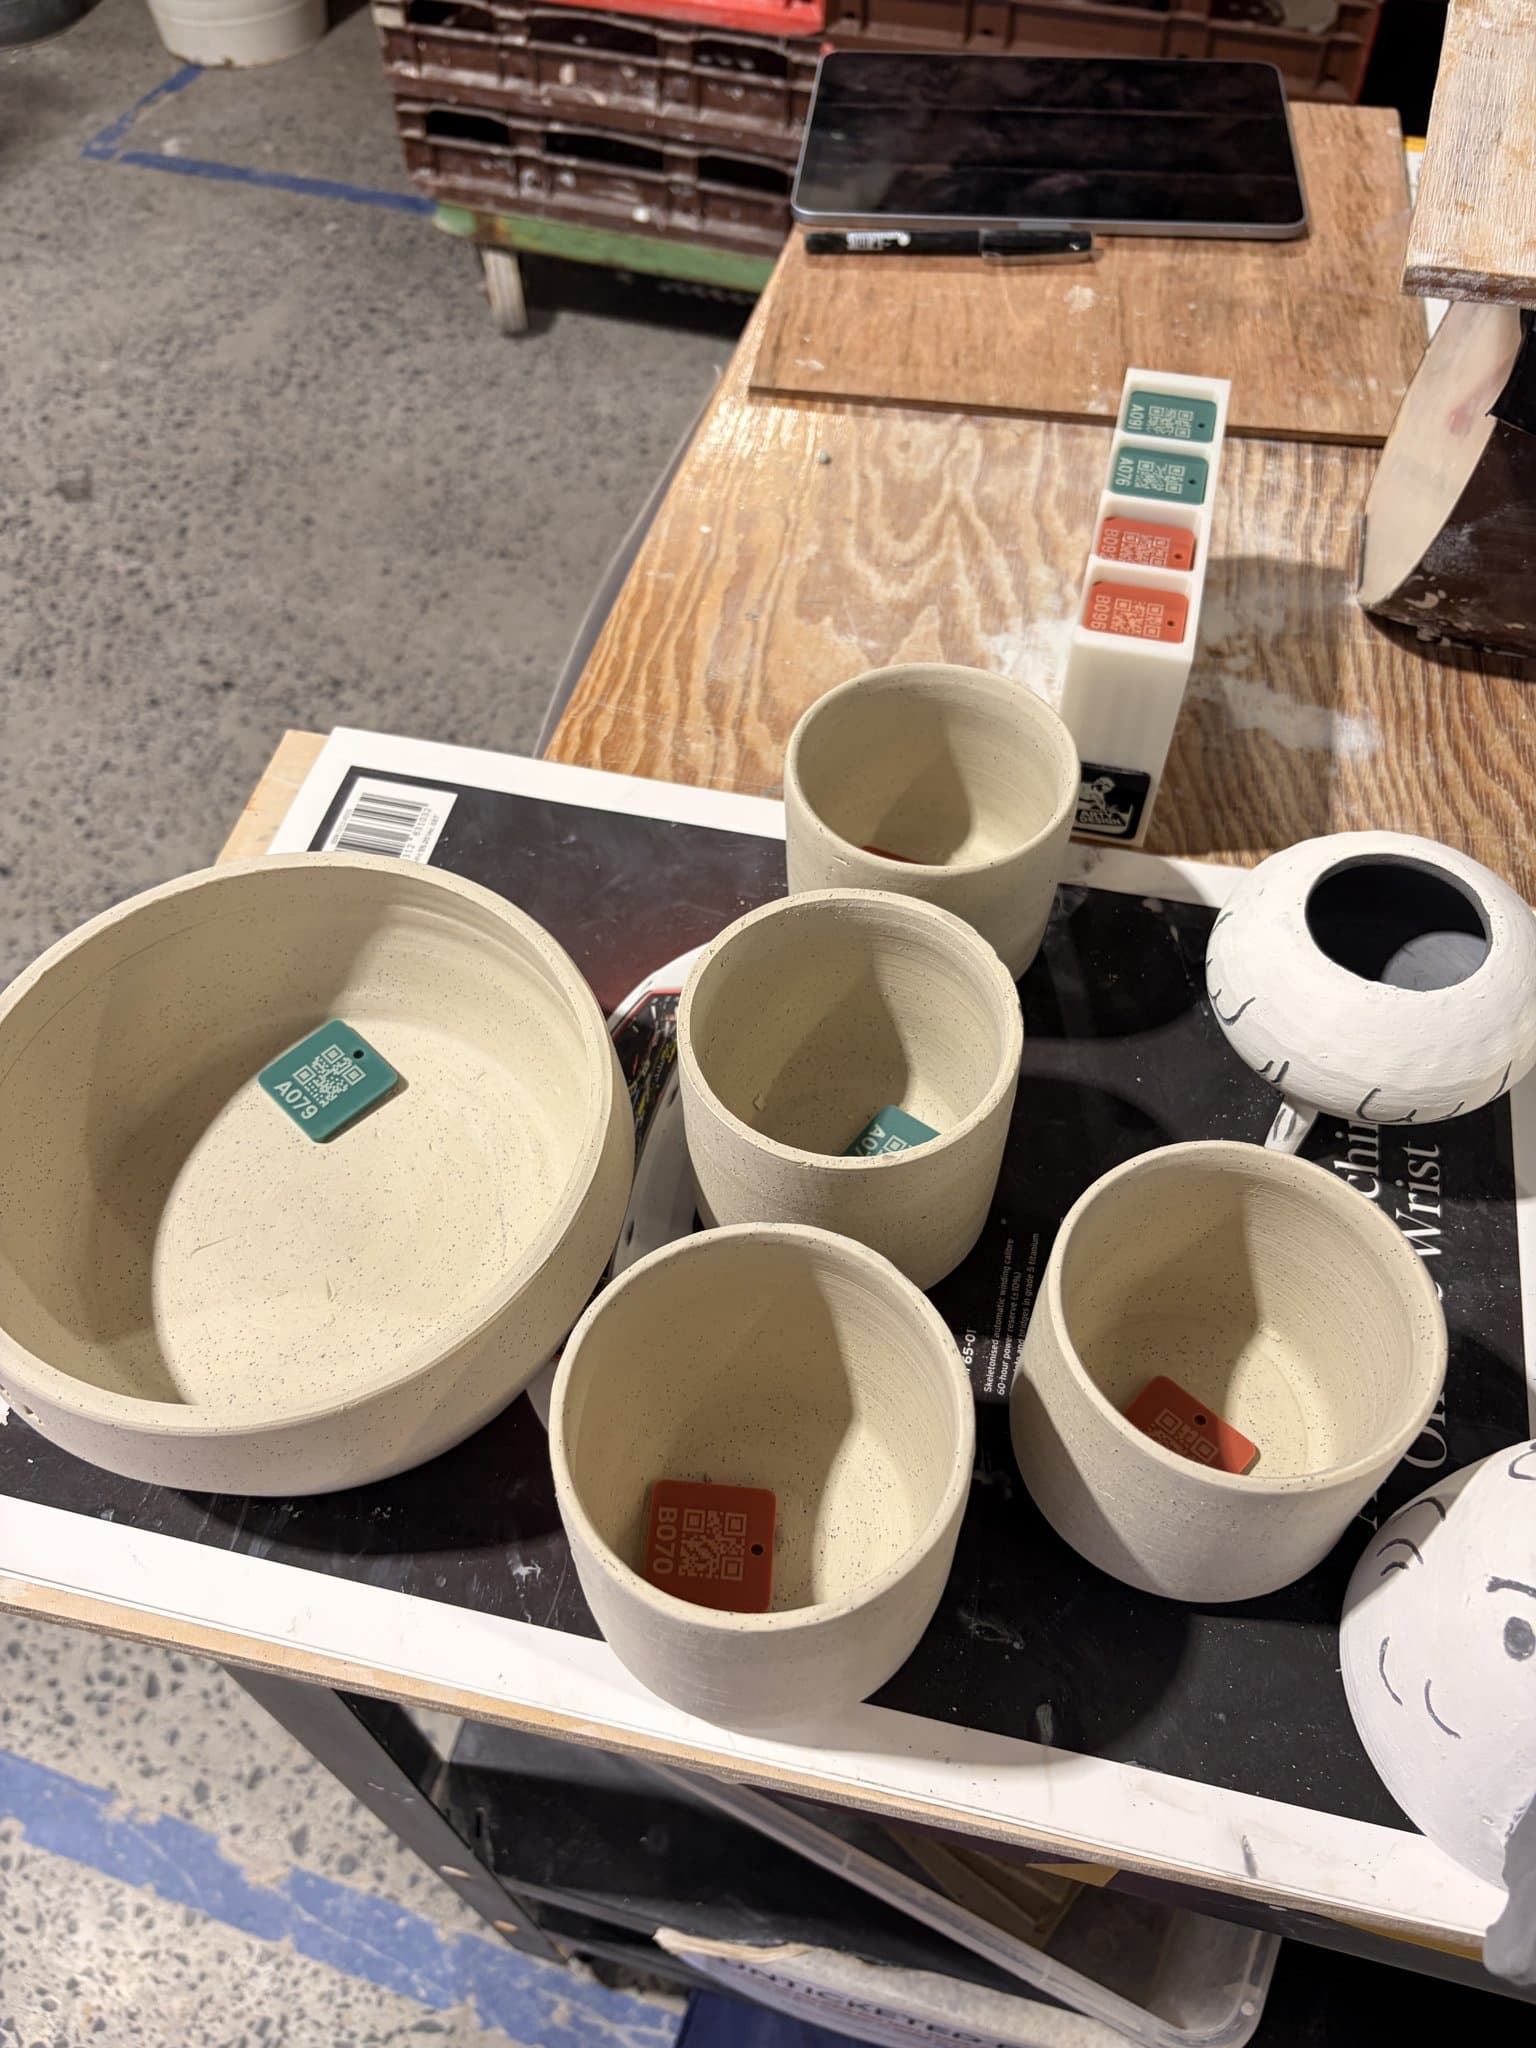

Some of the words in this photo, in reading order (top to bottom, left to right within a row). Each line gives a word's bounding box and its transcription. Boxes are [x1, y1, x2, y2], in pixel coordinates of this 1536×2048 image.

[1127, 403, 1146, 431] A091
[1115, 456, 1134, 487] A076
[1090, 594, 1111, 630] B096
[274, 1080, 318, 1120] A079
[1395, 1140, 1442, 1257] Wrist
[1004, 1237, 1014, 1265] calibre
[1028, 1232, 1040, 1264] titanium
[1000, 1265, 1012, 1297] winding
[1025, 1273, 1036, 1298] grade
[993, 1298, 1006, 1339] automatic
[1024, 1298, 1031, 1308] in
[1007, 1305, 1019, 1334] reserve
[962, 1329, 977, 1365] 65-01
[1003, 1335, 1014, 1360] power
[983, 1338, 999, 1394] Skeletonised
[996, 1359, 1010, 1396] 60-hour
[652, 1506, 679, 1575] B070
